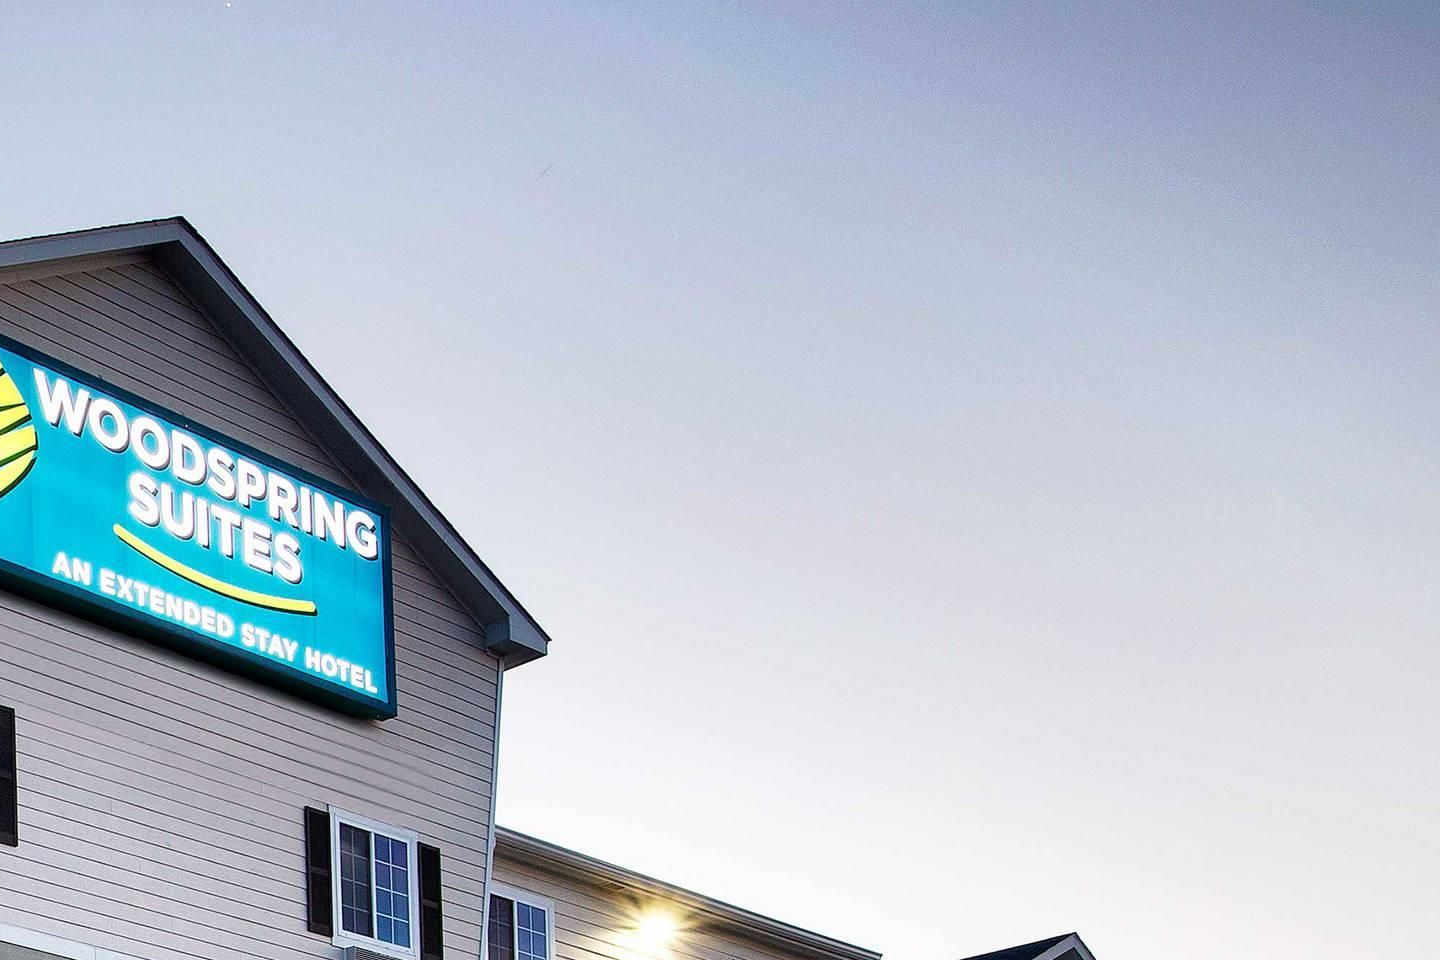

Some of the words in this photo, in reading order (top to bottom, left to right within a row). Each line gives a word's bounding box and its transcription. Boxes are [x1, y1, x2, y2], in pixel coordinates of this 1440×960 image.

[33, 368, 378, 559] WOODSPRING
[129, 473, 302, 584] SUITES
[52, 551, 91, 586] AN
[100, 569, 234, 638] EXTENDED
[241, 622, 298, 662] STAY
[305, 647, 378, 693] HOTEL
